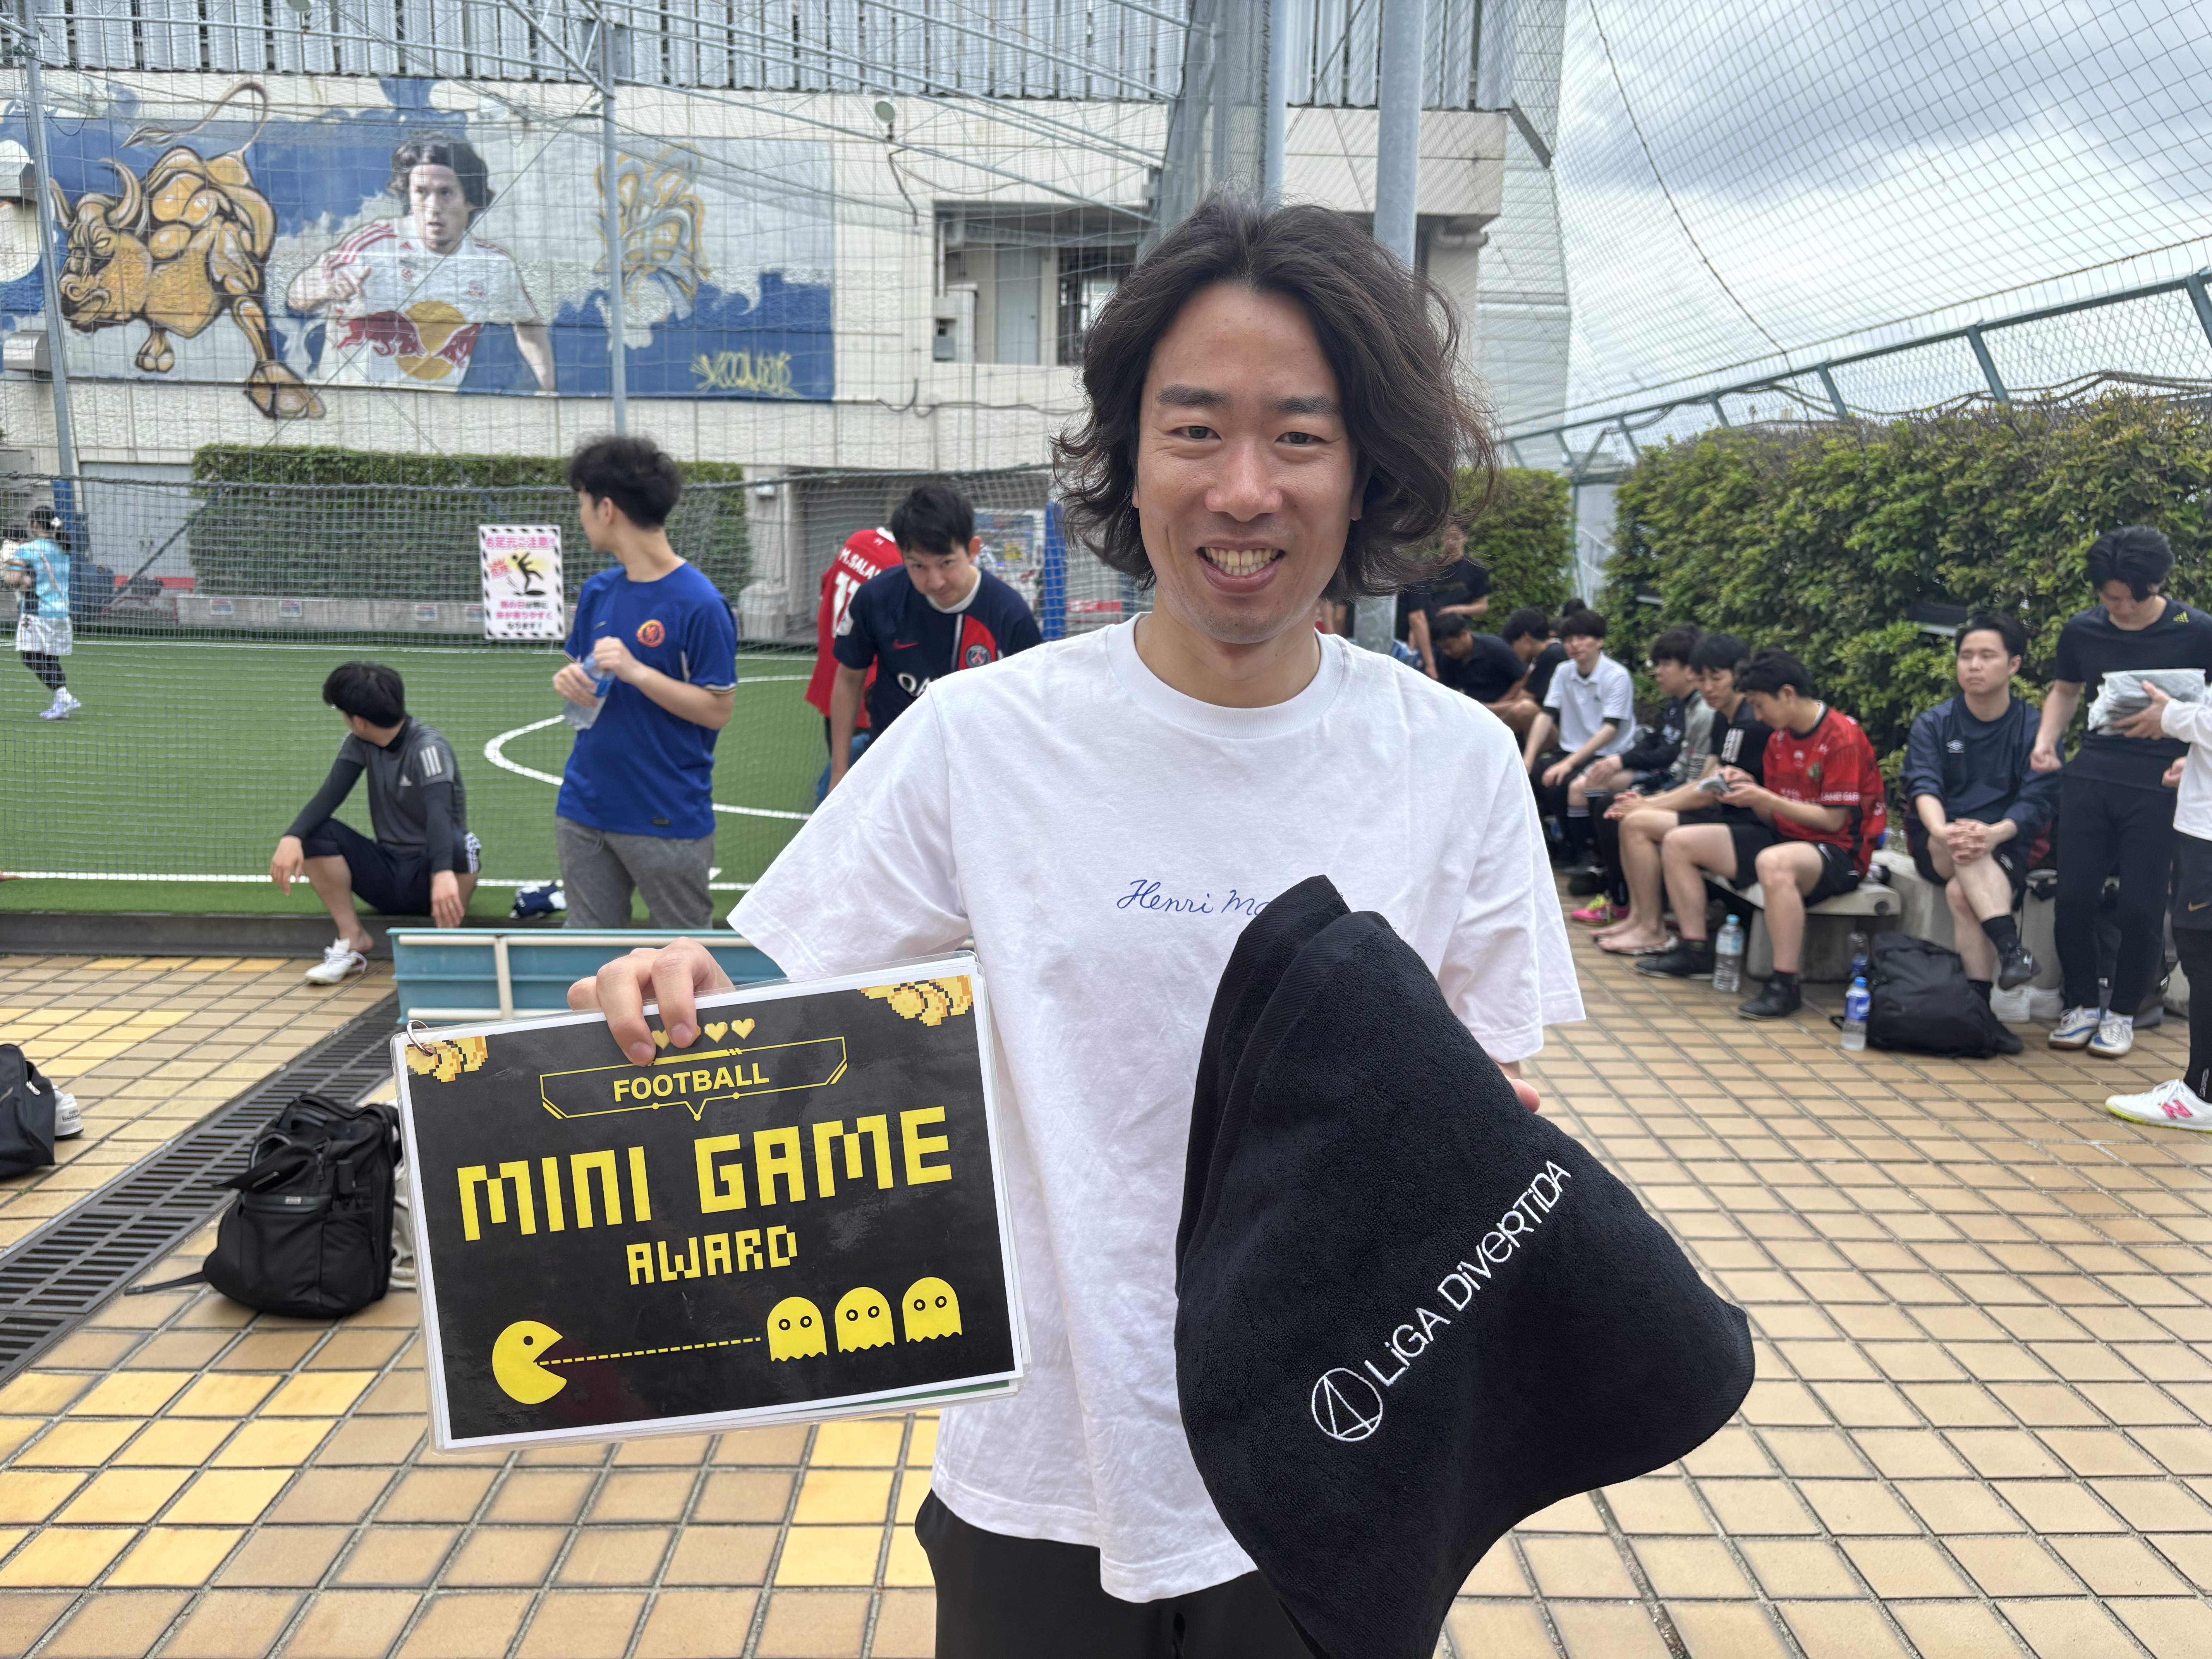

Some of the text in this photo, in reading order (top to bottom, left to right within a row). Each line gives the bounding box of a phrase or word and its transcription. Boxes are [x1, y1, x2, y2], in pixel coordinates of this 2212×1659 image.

[1117, 879, 1214, 913] Henri
[614, 1063, 769, 1102] FOOTBALL
[457, 1107, 953, 1241] MINI GAME
[627, 1225, 798, 1285] AWARD
